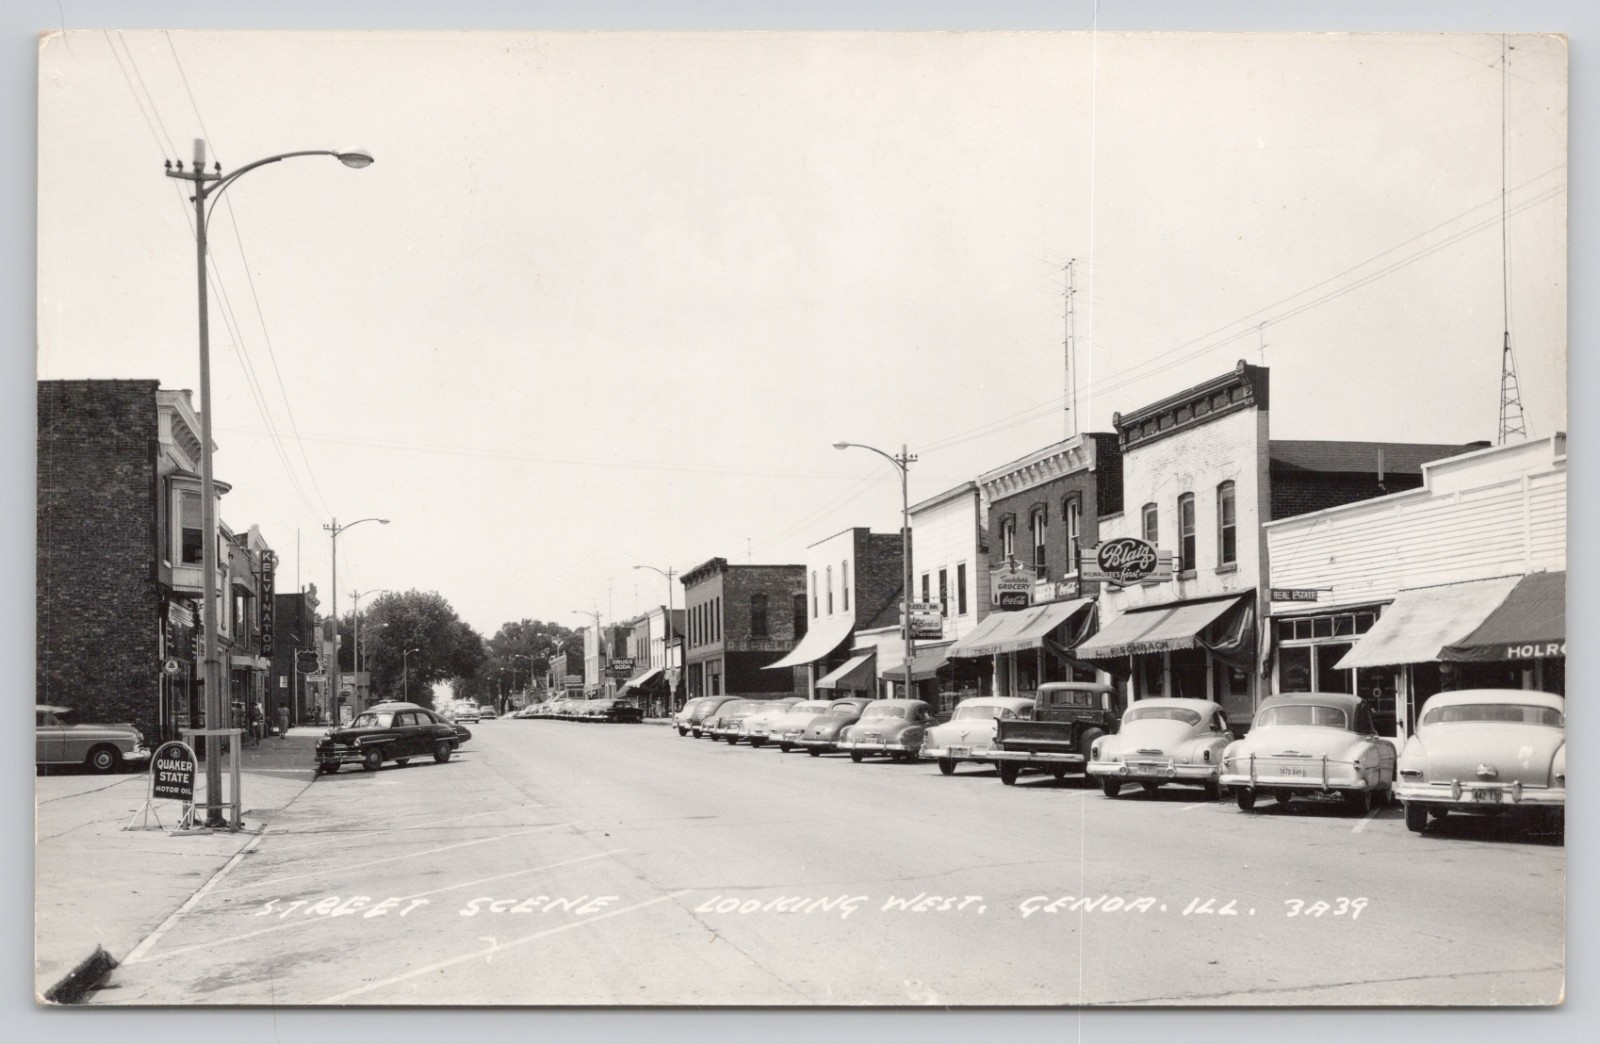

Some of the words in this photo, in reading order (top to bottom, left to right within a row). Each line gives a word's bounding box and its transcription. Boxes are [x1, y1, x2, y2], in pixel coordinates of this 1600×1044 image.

[1101, 540, 1155, 569] Blatz
[1273, 591, 1290, 600] REAL
[1292, 591, 1317, 600] ESTATE
[262, 552, 272, 653] KELVINATOR
[157, 758, 193, 772] QUAKER
[159, 771, 190, 784] STATE
[155, 785, 180, 793] MOTOR
